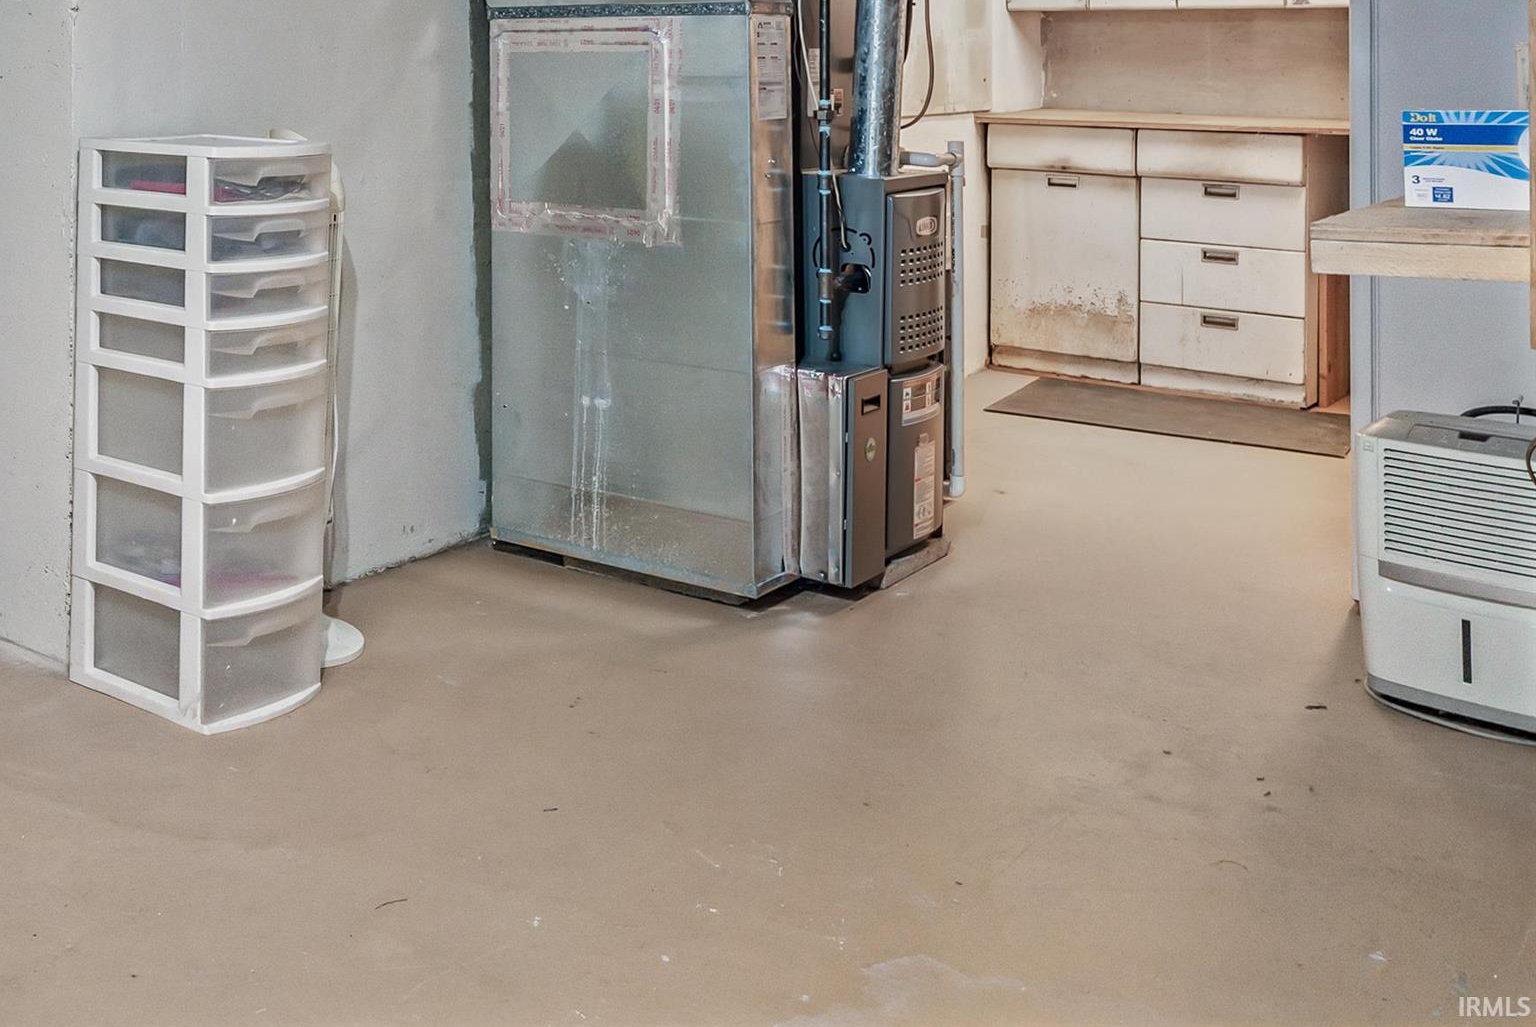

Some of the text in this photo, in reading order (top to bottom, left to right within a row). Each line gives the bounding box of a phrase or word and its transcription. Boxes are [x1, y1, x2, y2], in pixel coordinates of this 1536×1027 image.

[1409, 128, 1438, 136] 40 W
[1412, 175, 1421, 184] 3
